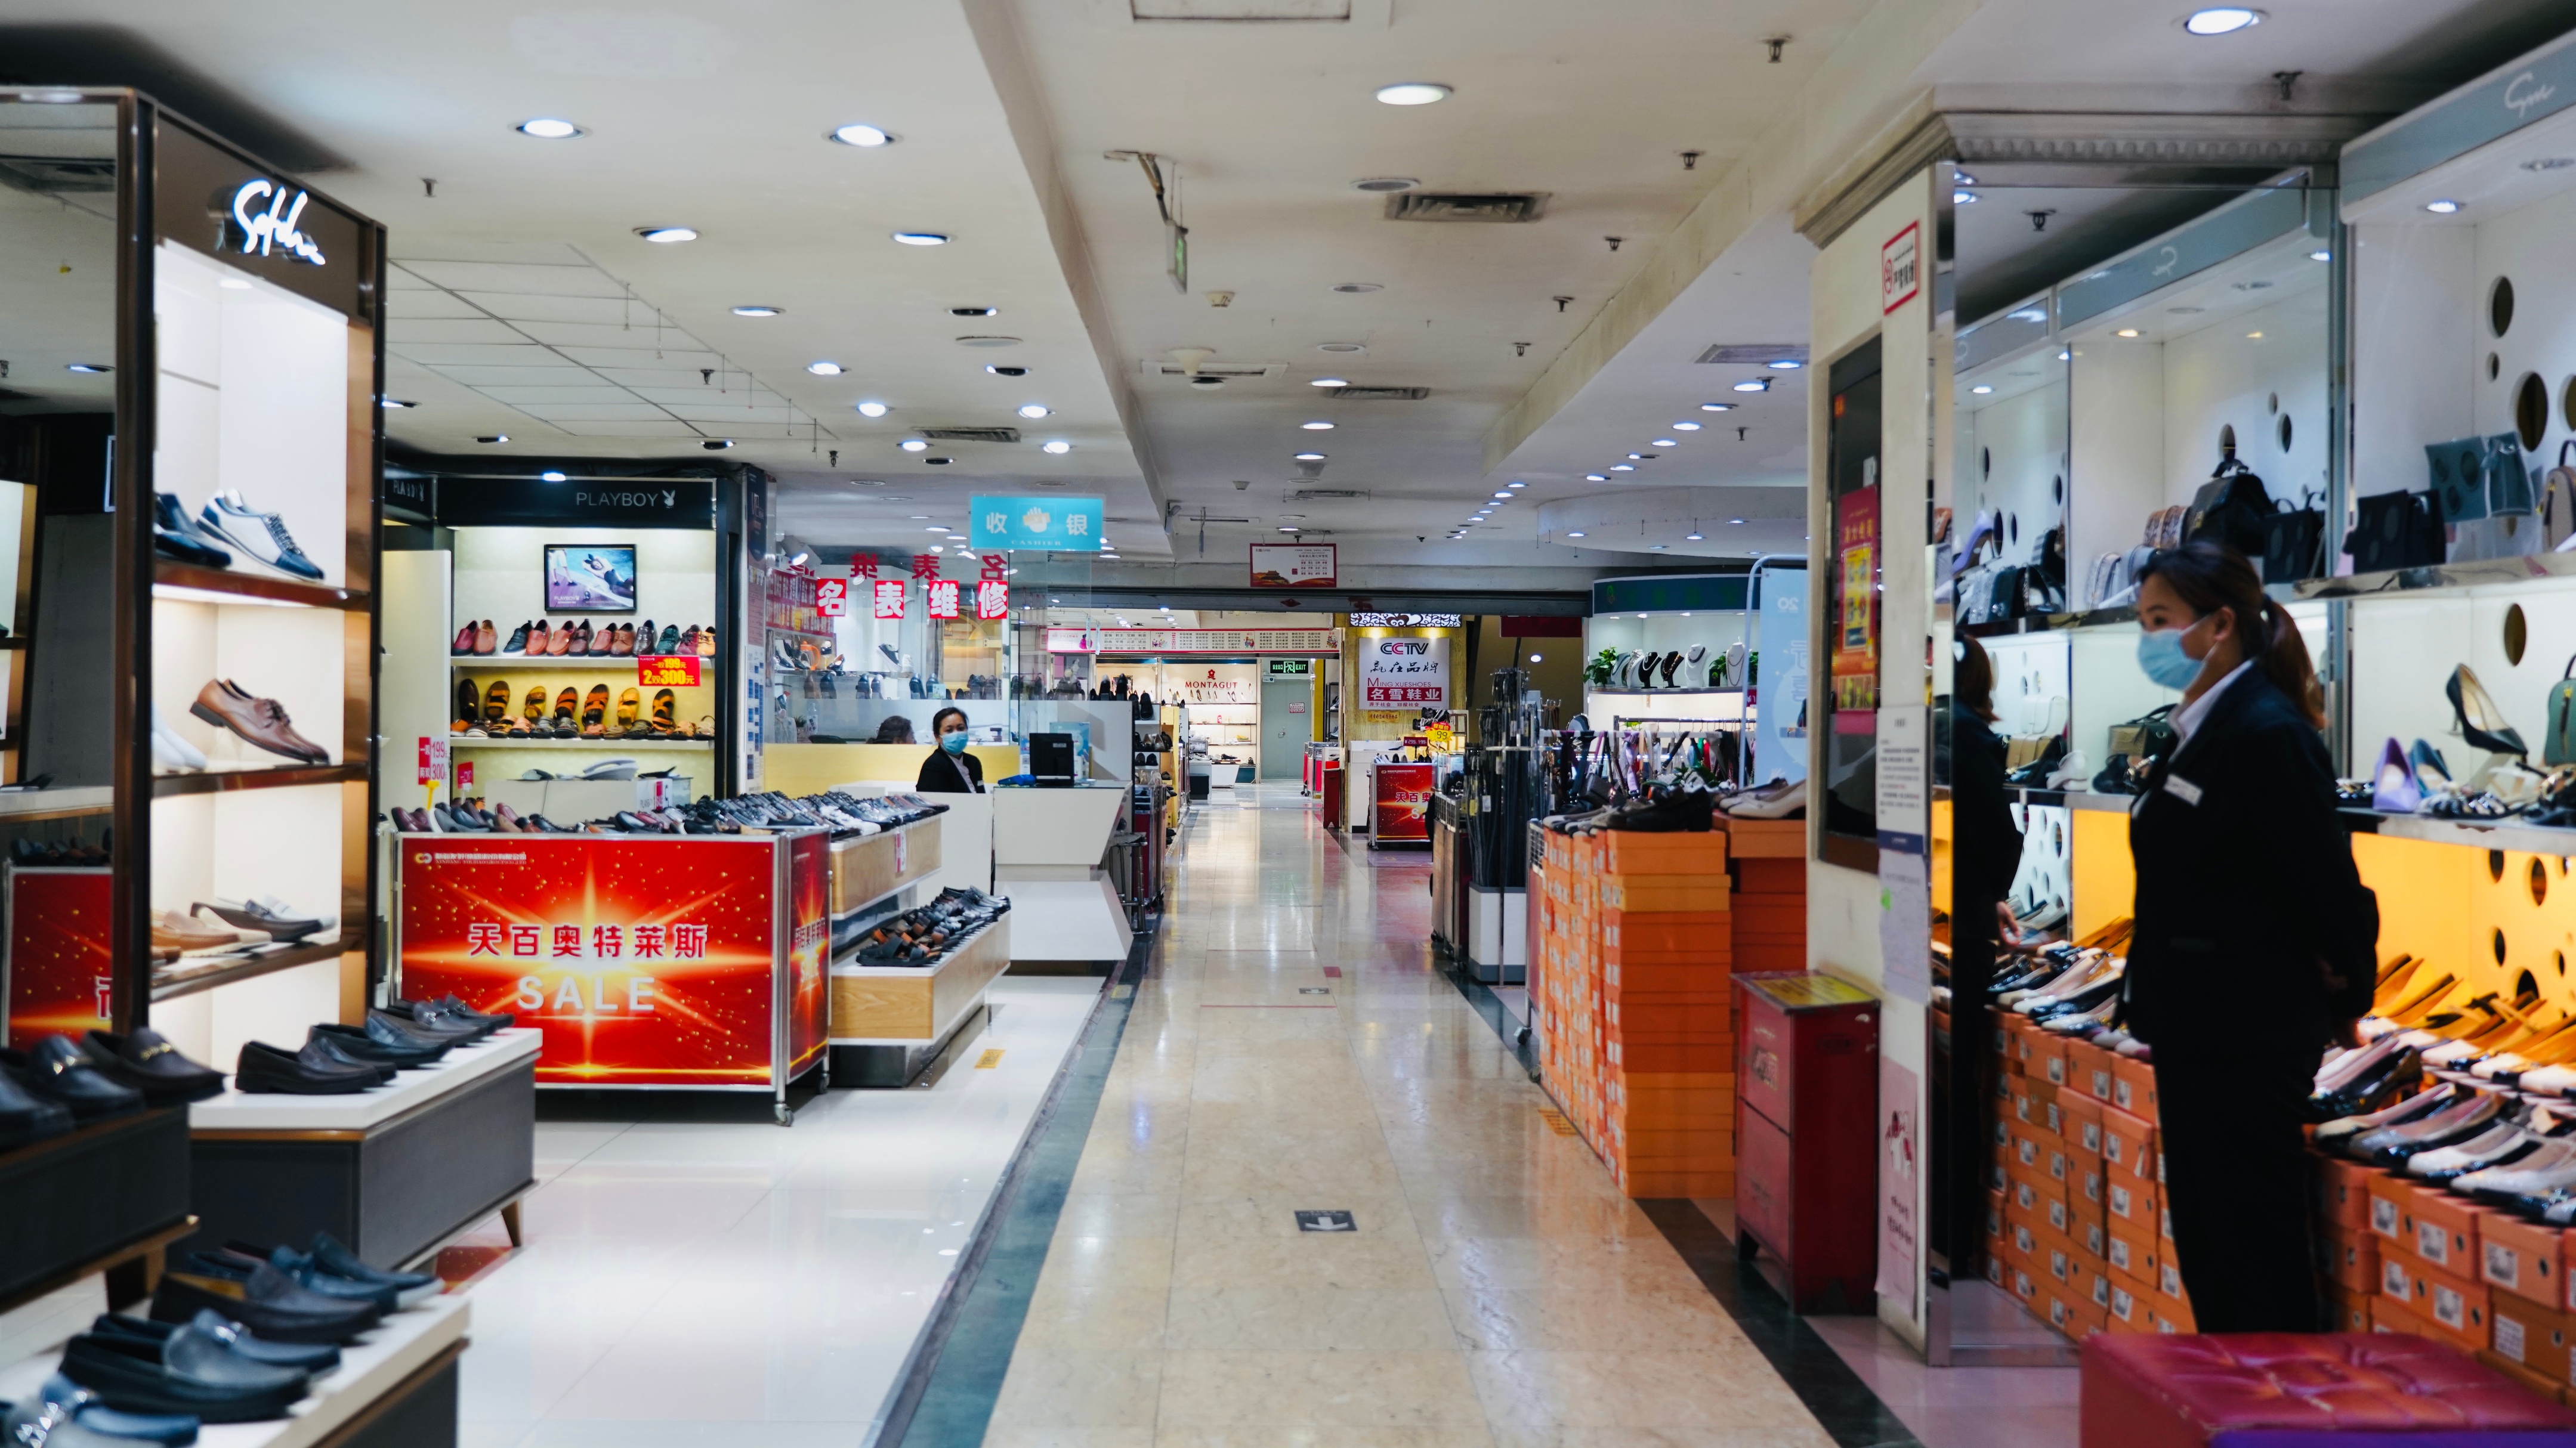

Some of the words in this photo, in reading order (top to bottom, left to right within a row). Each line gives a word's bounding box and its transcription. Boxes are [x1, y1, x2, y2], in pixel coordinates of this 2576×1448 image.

[576, 493, 659, 506] PLAYBOY
[986, 512, 1088, 536] 收银
[818, 580, 1008, 618] 名表维修
[1380, 642, 1429, 655] CCTV
[651, 658, 687, 669] 一双199元
[643, 669, 695, 685] 2双300元
[1370, 688, 1440, 701] 名雪鞋业
[1437, 731, 1448, 740] 99
[467, 923, 708, 960] 天百奥特莱斯
[517, 976, 655, 1011] SALE
